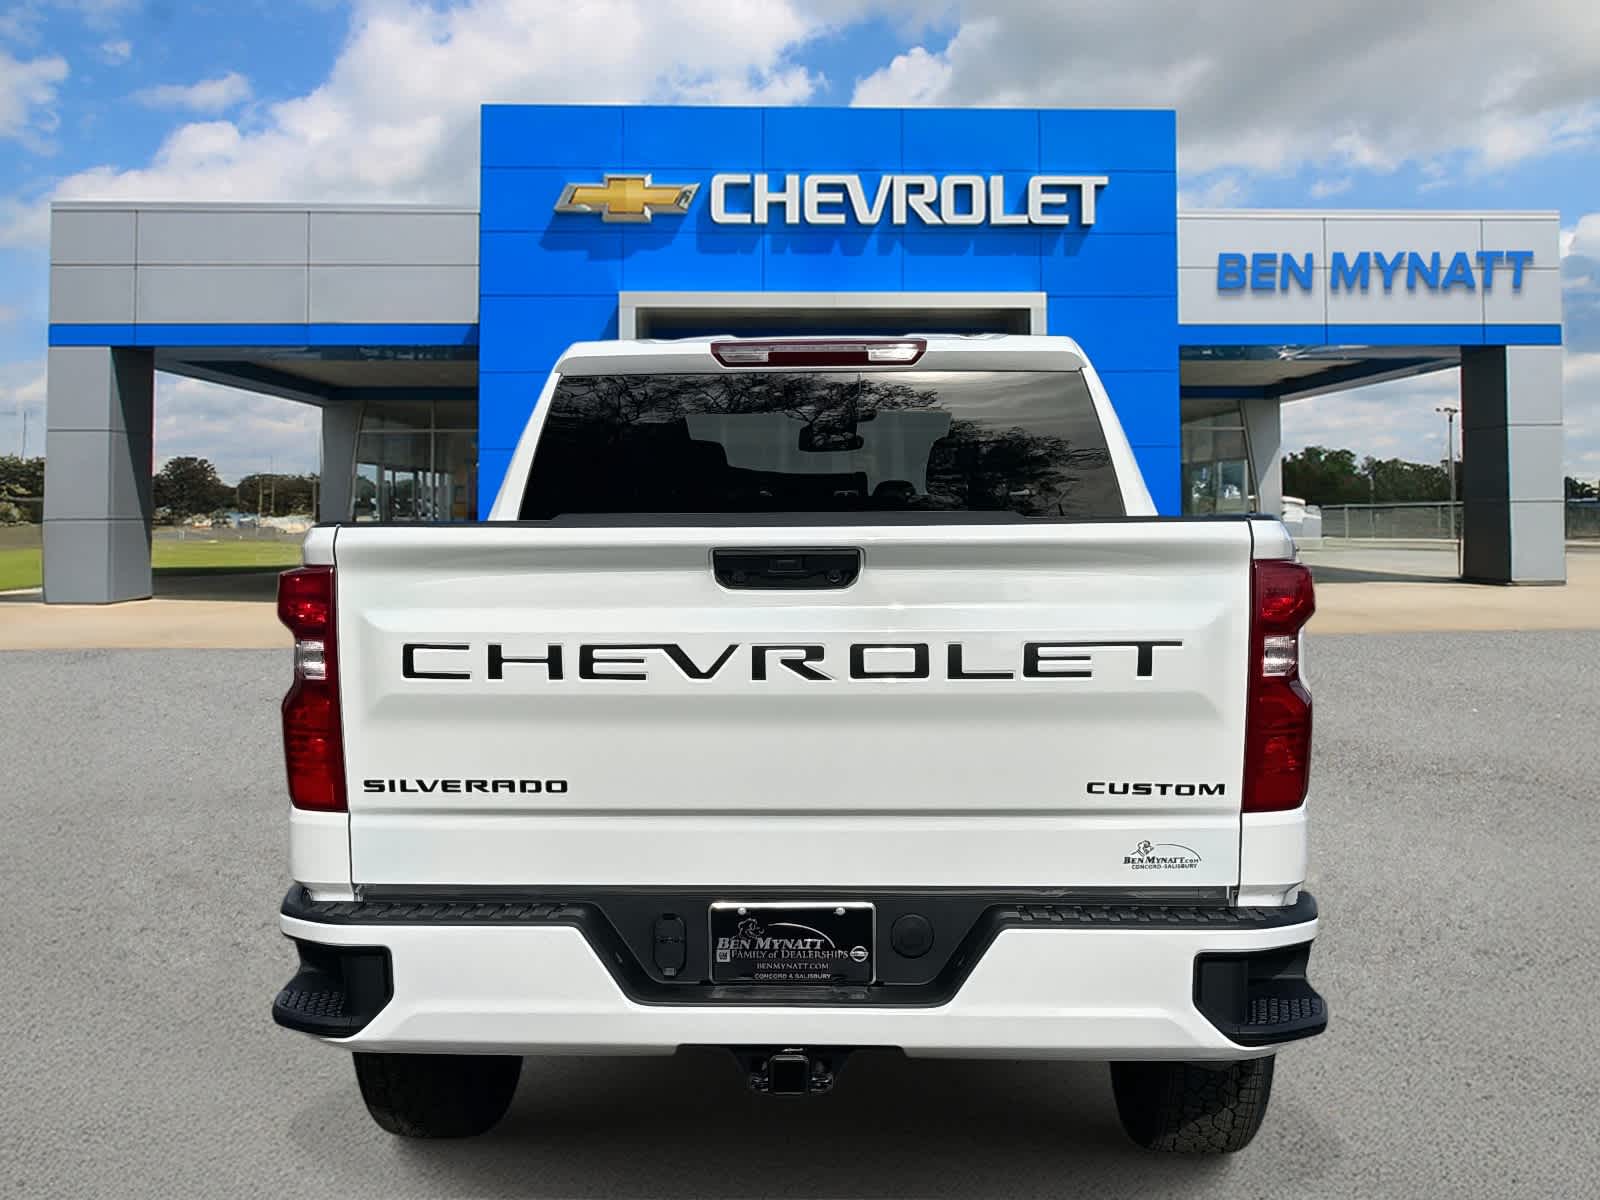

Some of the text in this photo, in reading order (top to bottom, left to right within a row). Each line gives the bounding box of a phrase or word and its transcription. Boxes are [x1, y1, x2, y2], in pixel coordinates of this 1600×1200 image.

[710, 173, 1109, 225] CHEVROLET
[1217, 250, 1534, 290] BEN MYNATT
[402, 640, 1184, 681] CHEVROLET
[363, 778, 568, 793] SILVERADO
[1086, 781, 1226, 796] CUSTOM
[717, 937, 825, 950] BEN MYNATT
[731, 950, 767, 959] FAMILY
[781, 950, 849, 960] DEALERSHIPS
